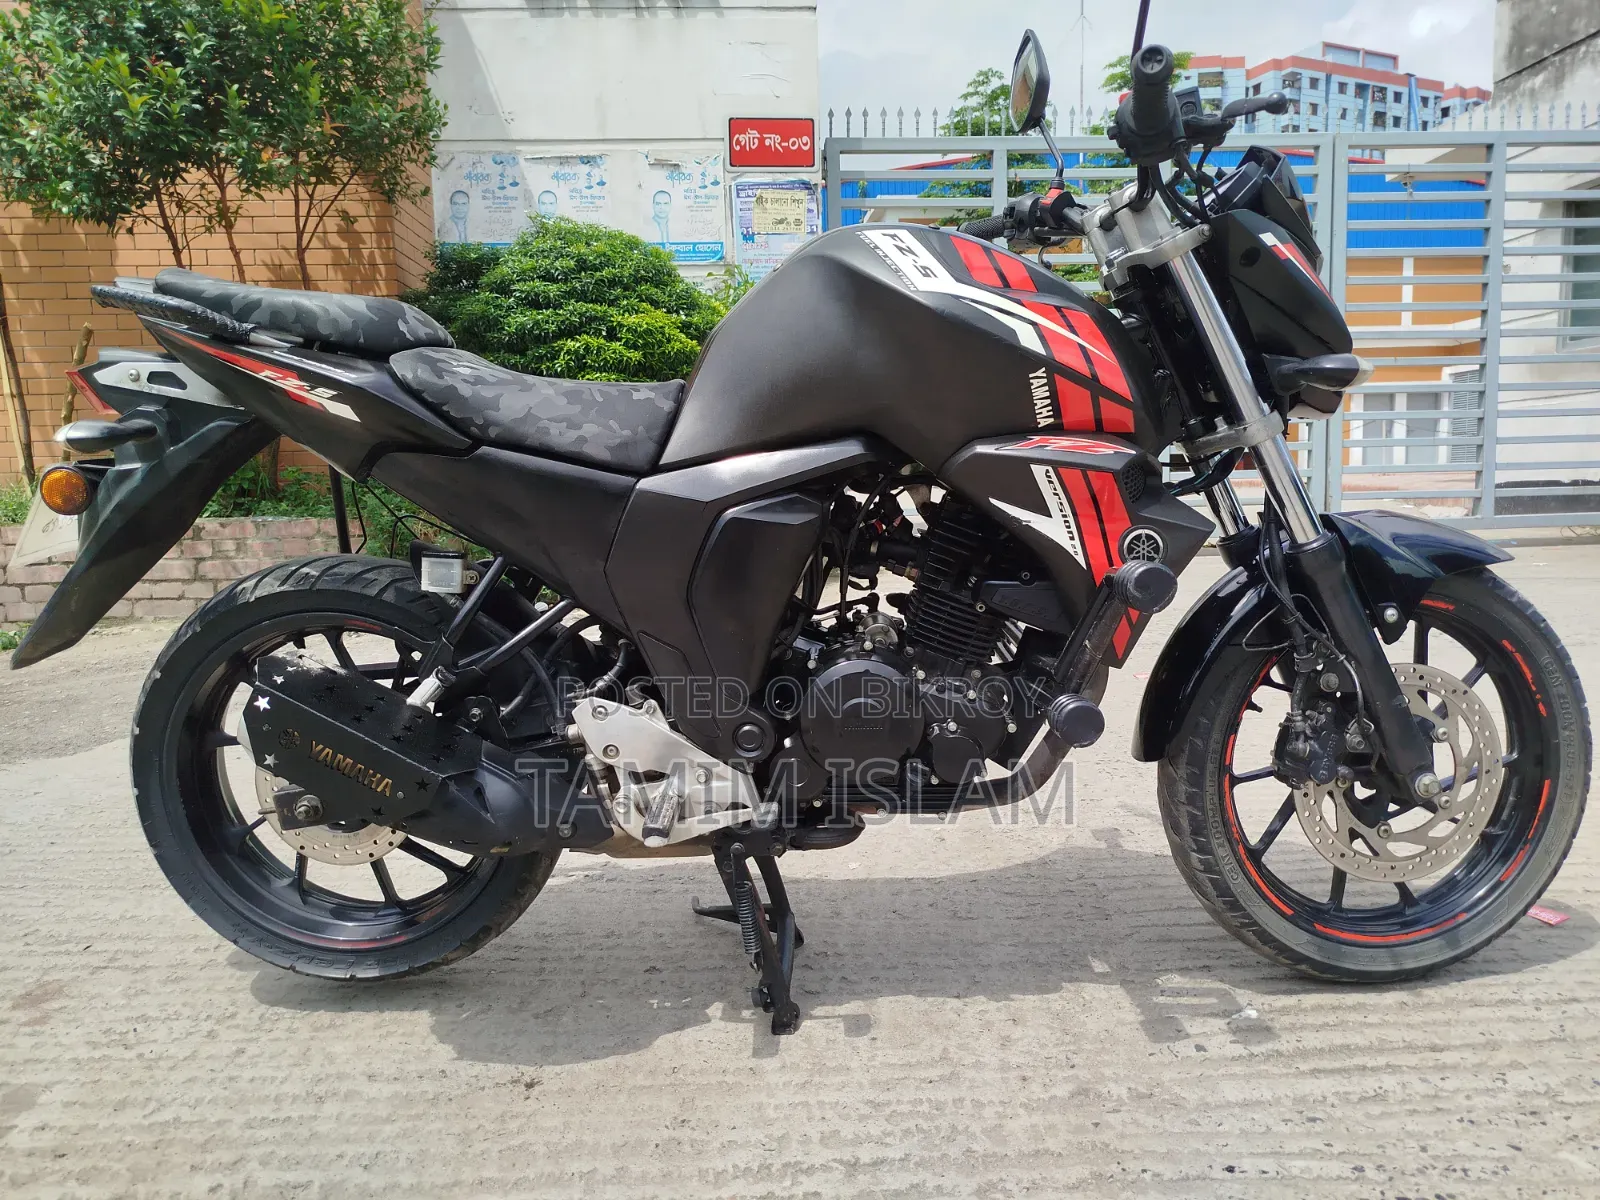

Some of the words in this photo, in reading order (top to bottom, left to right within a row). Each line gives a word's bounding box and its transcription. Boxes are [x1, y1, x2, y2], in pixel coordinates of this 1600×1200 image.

[733, 128, 760, 151] গেট
[880, 232, 939, 279] FZ-S
[1028, 366, 1055, 428] YAMAHA
[1044, 468, 1076, 542] version
[308, 740, 393, 797] YAMAHA
